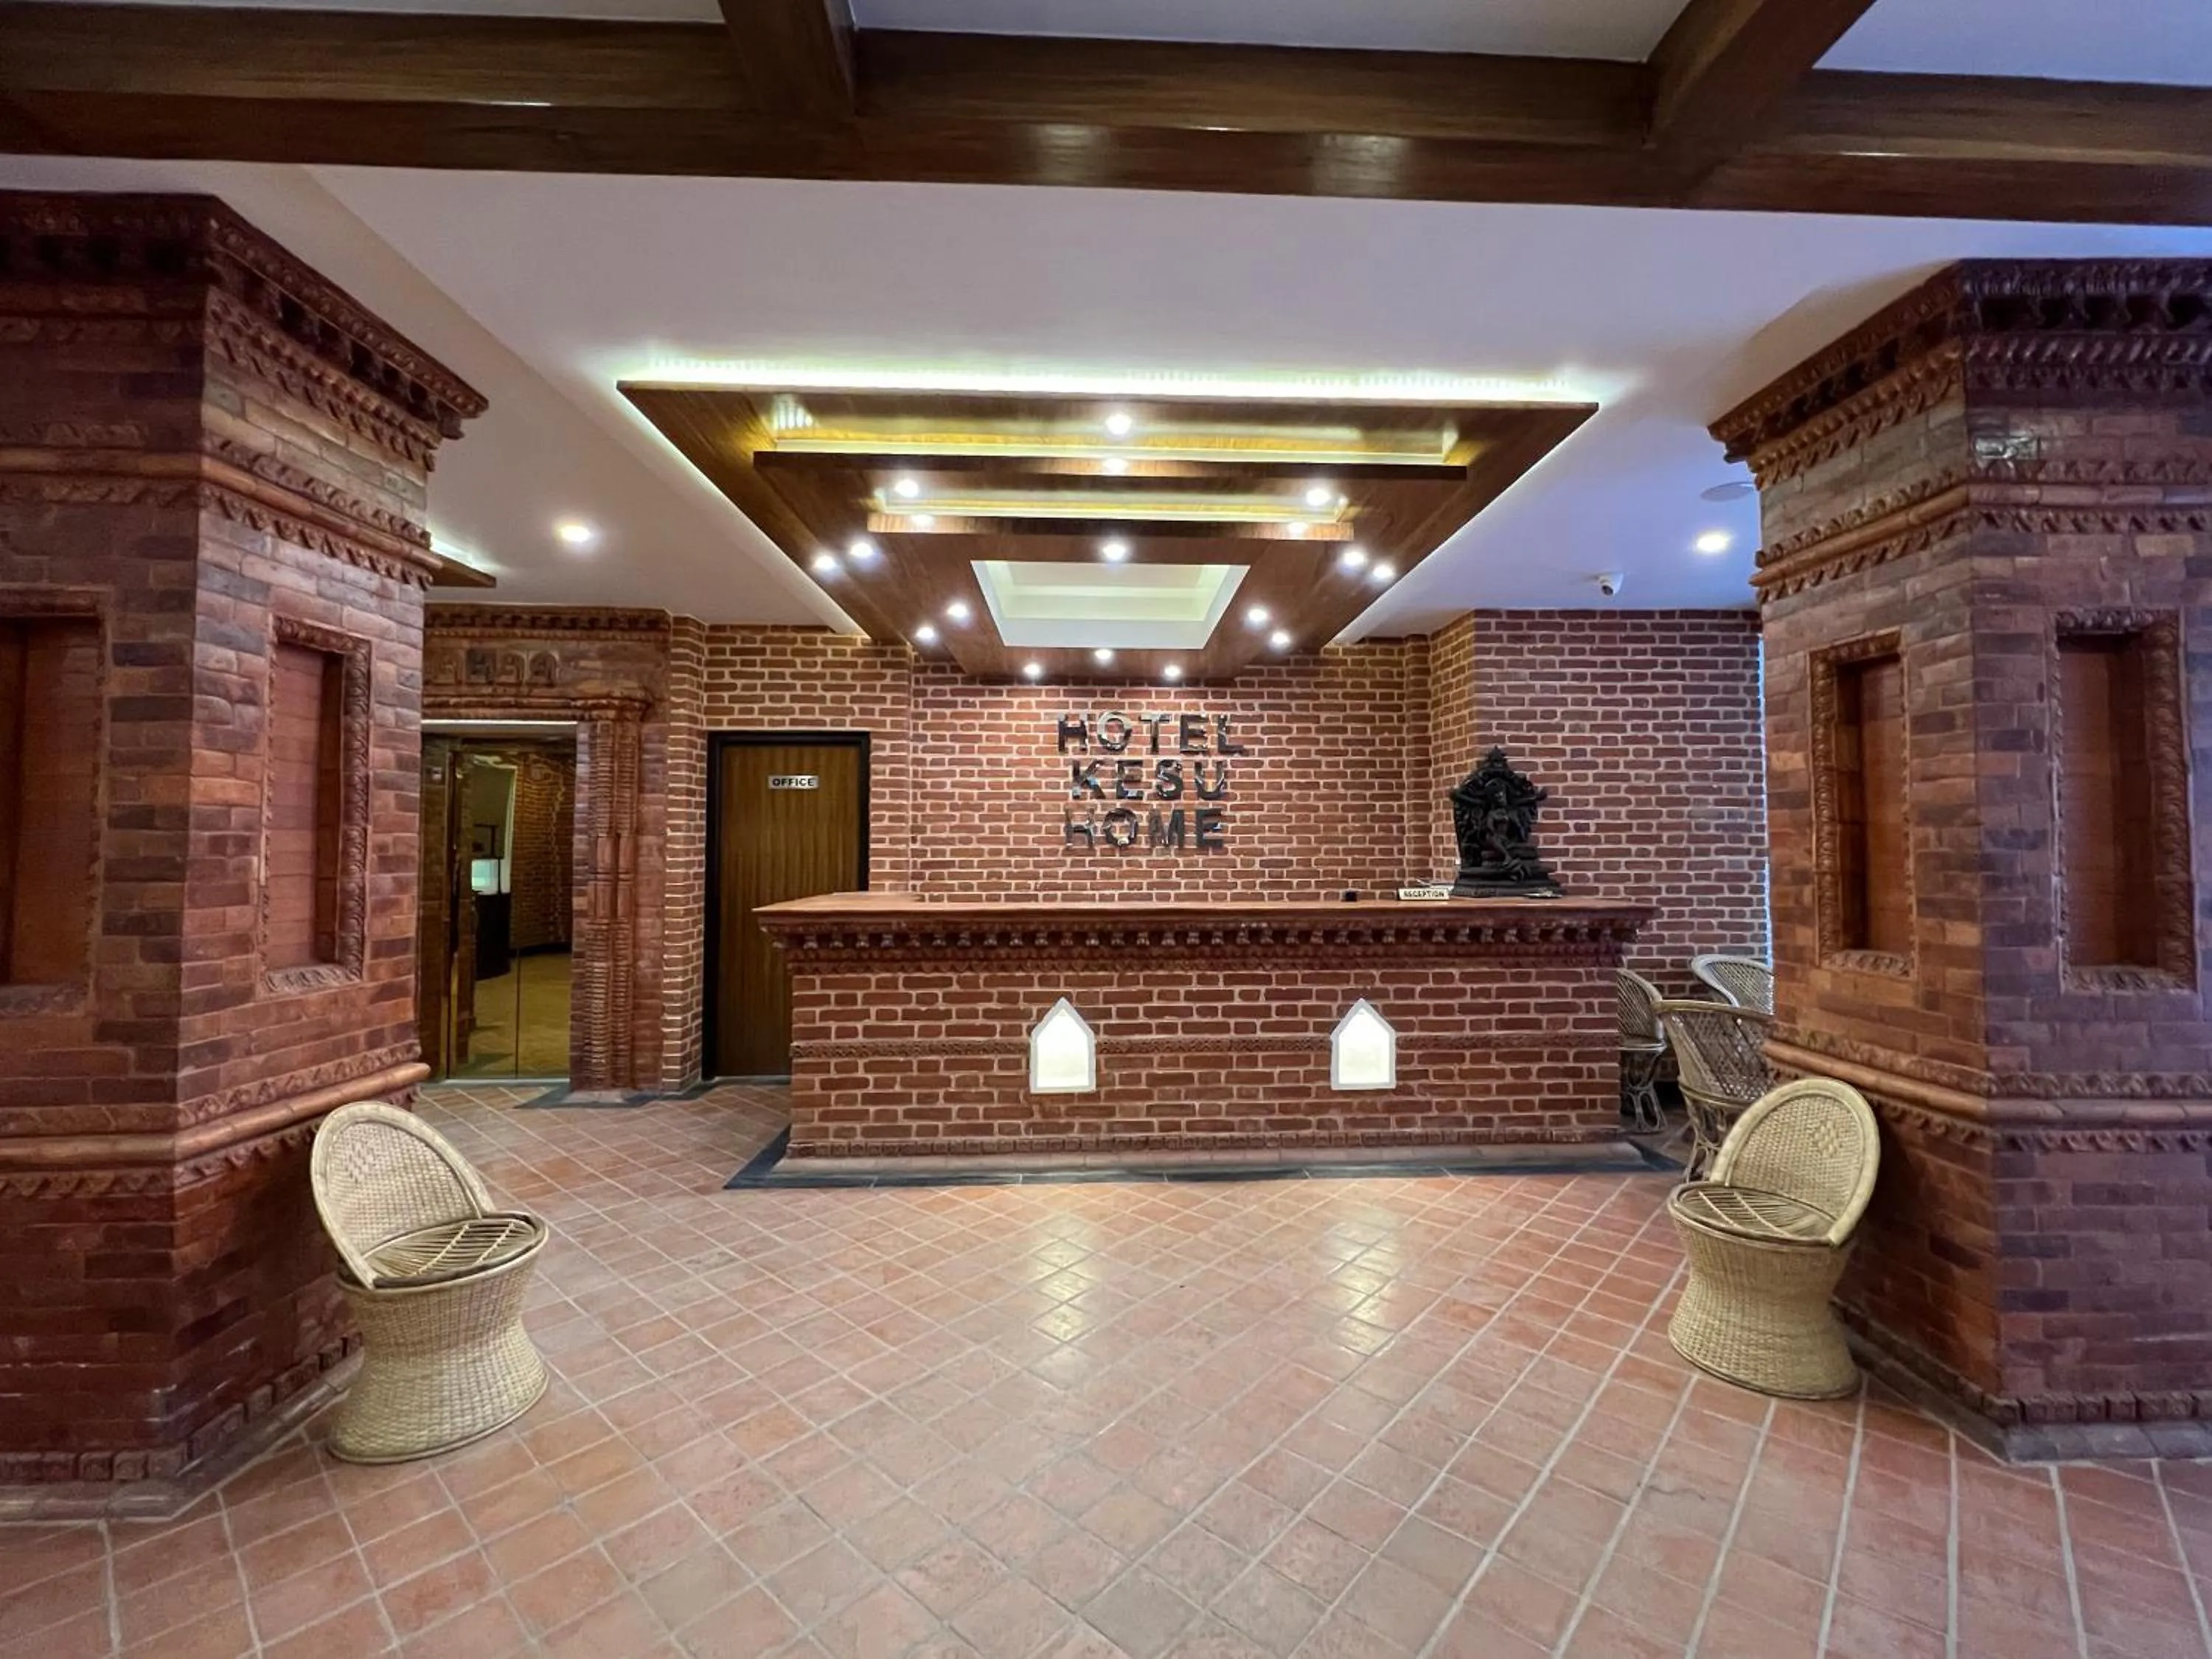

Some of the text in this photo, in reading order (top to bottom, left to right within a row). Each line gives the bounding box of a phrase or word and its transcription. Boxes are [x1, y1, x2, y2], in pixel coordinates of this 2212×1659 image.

[1058, 711, 1245, 754] HOTEL
[772, 778, 815, 786] OFFICE
[1072, 759, 1227, 799] KESU
[1065, 807, 1223, 848] HOME
